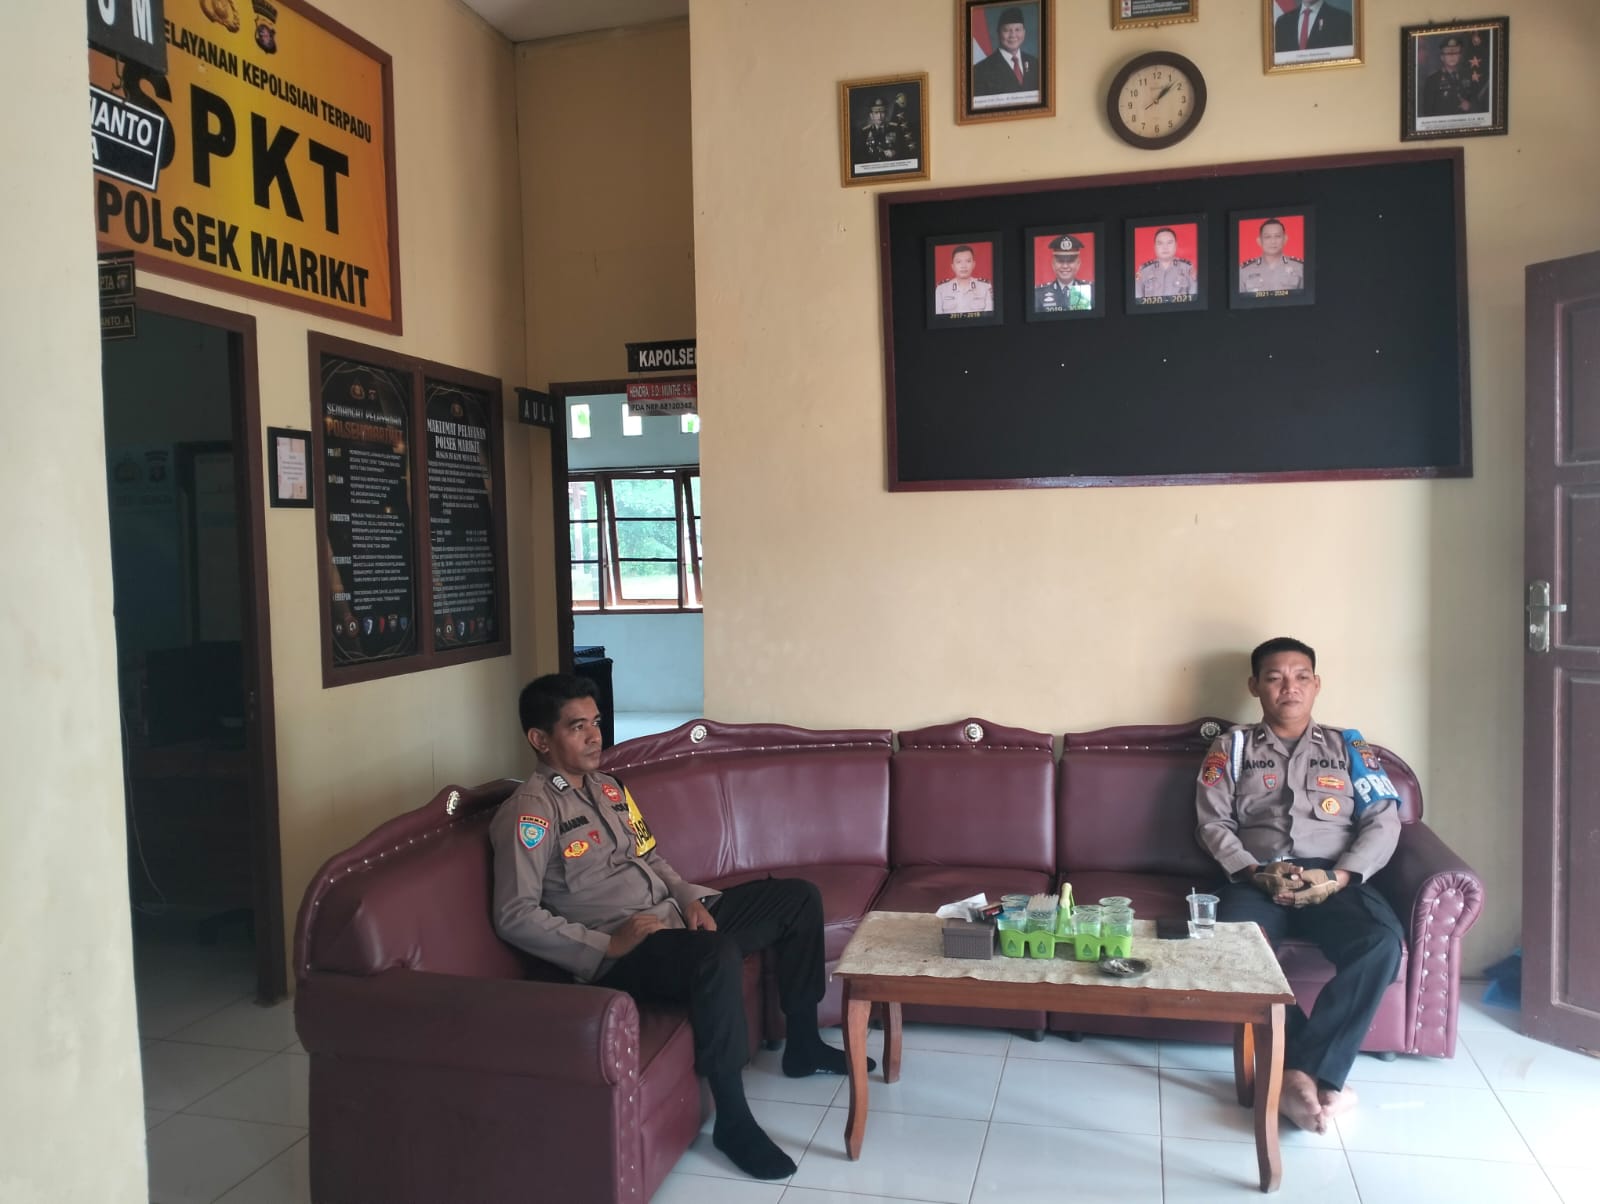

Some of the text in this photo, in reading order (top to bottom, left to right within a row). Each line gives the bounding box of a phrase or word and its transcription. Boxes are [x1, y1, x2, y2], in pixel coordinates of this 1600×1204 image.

[242, 59, 319, 117] KEPOLISIAN
[321, 100, 372, 144] TERPADU
[98, 179, 369, 308] POLSEK MARIKIT
[639, 347, 697, 368] KAPOLSE
[524, 399, 554, 424] AULA
[435, 435, 457, 451] POLSEK
